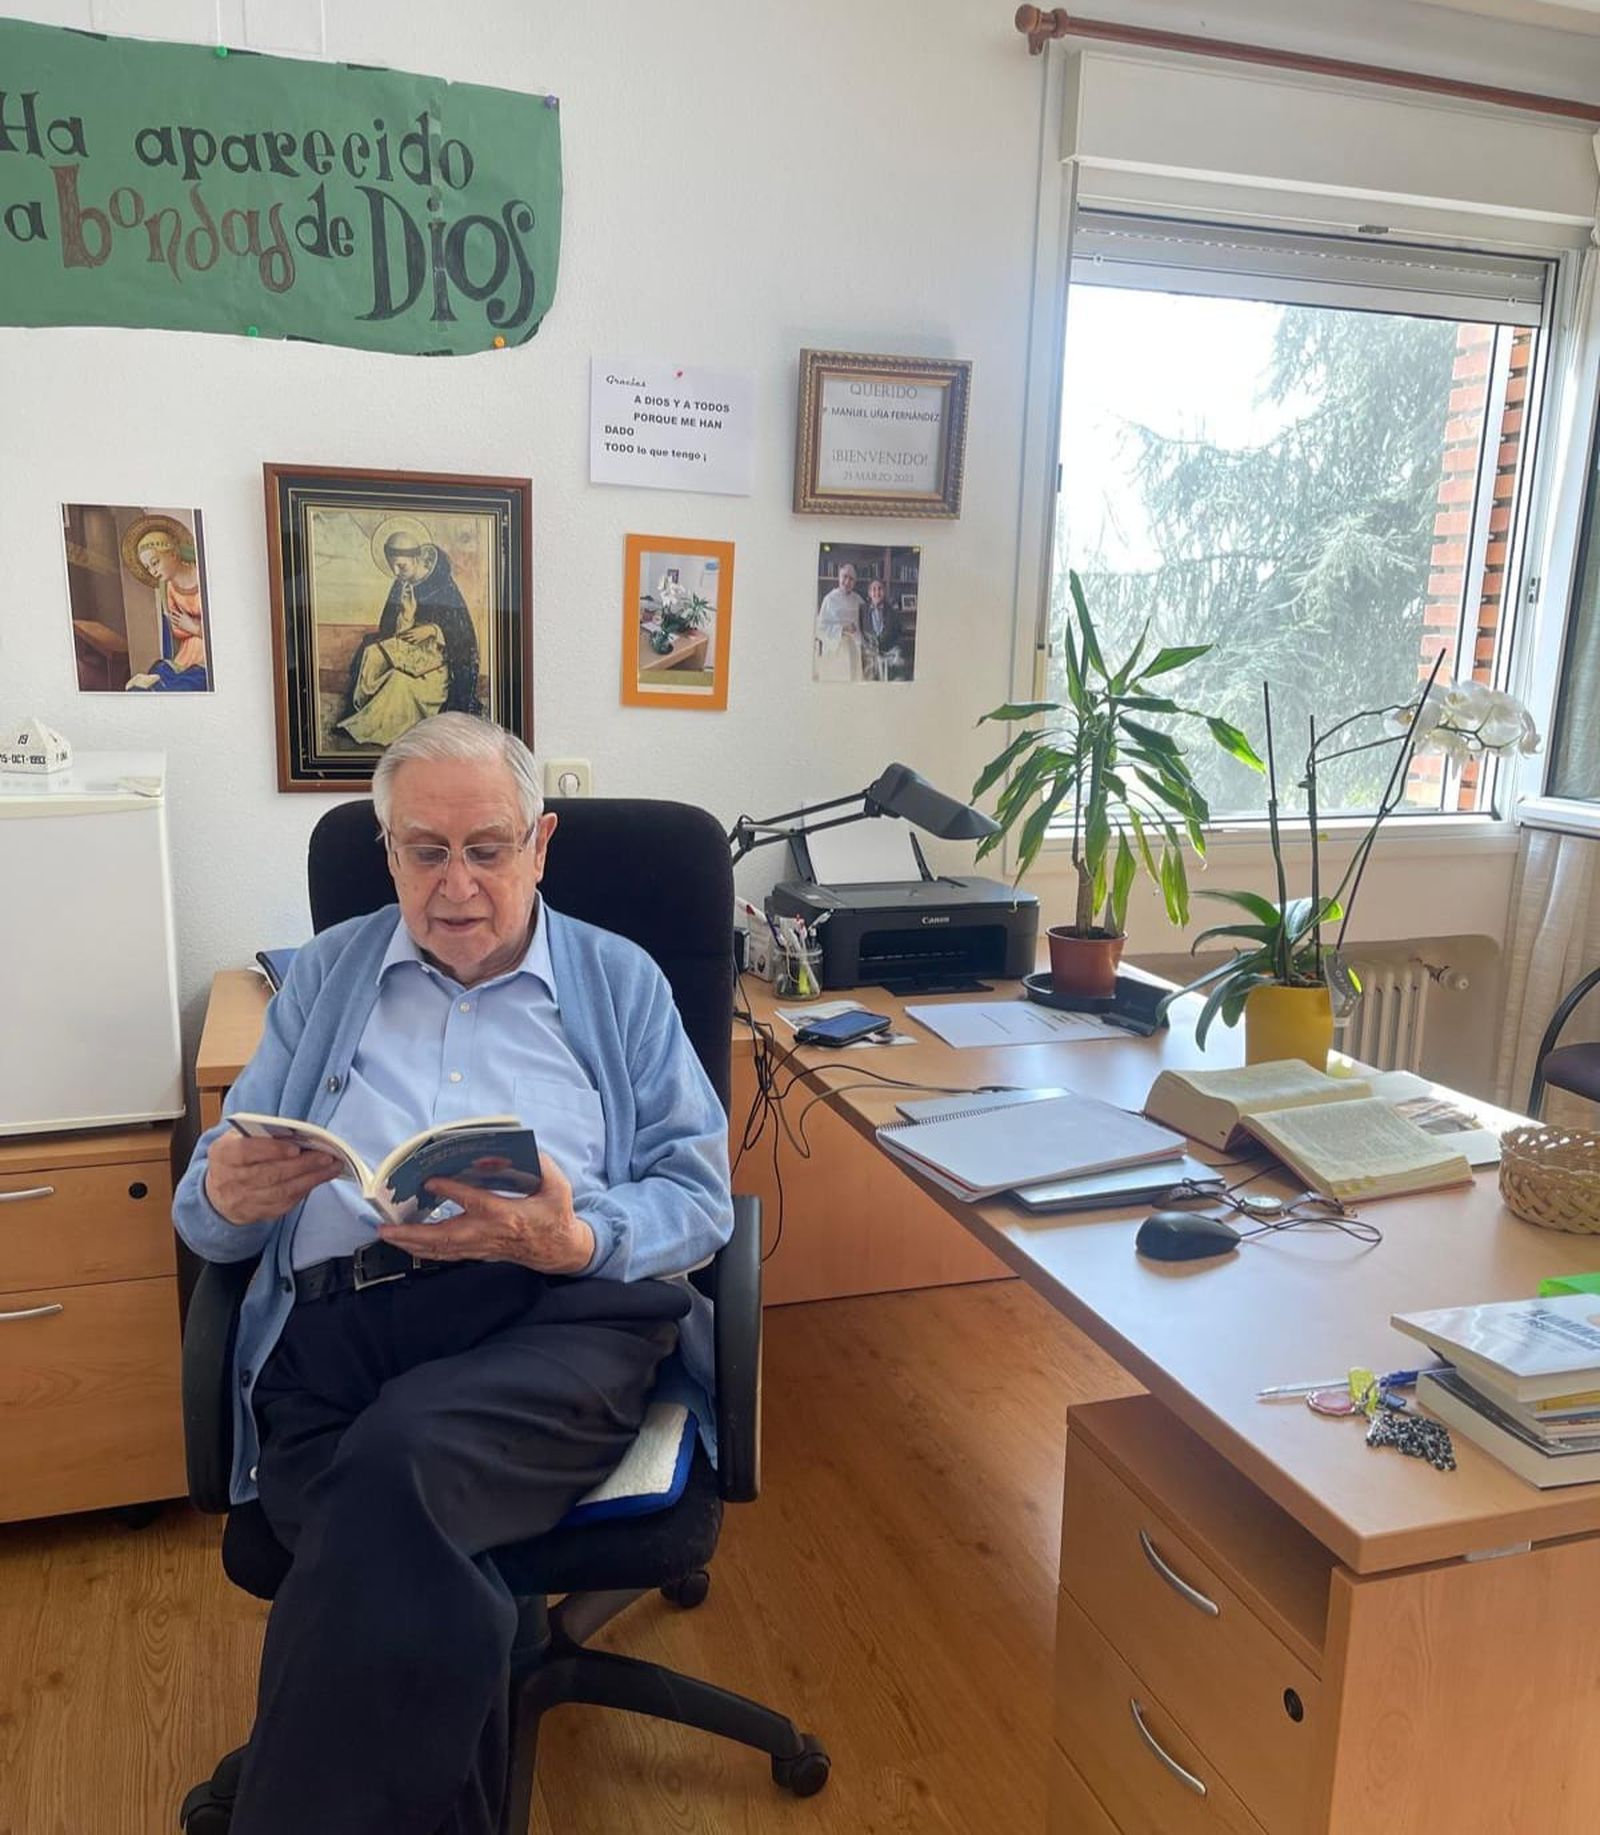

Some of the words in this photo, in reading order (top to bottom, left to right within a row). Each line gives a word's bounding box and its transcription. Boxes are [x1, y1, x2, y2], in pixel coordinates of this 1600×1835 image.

[0, 91, 90, 159] Ha
[135, 111, 475, 190] aparecido
[295, 182, 355, 259] de
[606, 375, 647, 388] Gracias
[849, 383, 918, 399] QUERIDO
[633, 395, 642, 405] A
[644, 396, 671, 408] DIOS
[673, 399, 681, 409] Y
[683, 400, 691, 410] A
[694, 401, 731, 413] TODOS
[831, 407, 868, 418] MANUEL
[633, 412, 678, 426] PORQUE
[680, 417, 697, 428] ME
[699, 419, 722, 430] HAN
[604, 425, 635, 437] DADO
[604, 442, 635, 454] TODO
[637, 445, 647, 454] lo
[649, 448, 669, 458] que
[671, 449, 701, 462] tengo
[854, 471, 892, 482] MARZO
[921, 916, 950, 925] Canon
